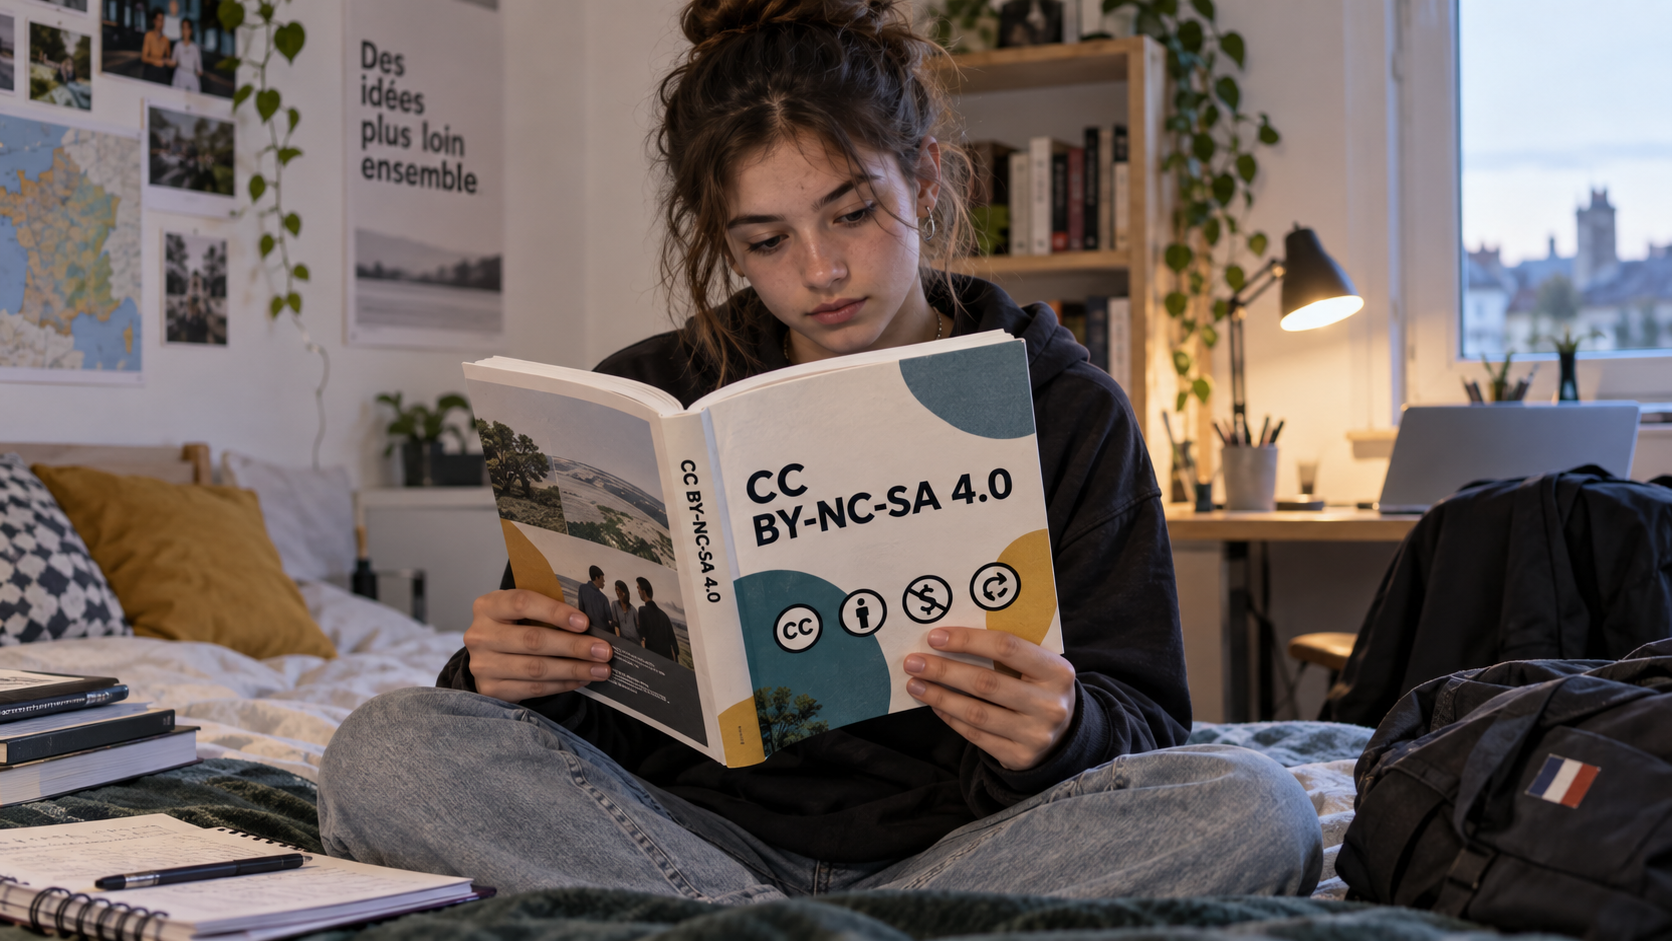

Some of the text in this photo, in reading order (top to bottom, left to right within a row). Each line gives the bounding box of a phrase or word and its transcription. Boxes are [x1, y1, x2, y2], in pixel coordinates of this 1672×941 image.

[361, 39, 405, 77] Des
[361, 74, 425, 115] idées
[361, 113, 465, 158] plus loin
[361, 156, 478, 195] ensemble
[746, 463, 808, 504] CC
[753, 467, 1012, 547] BY-NC-SA 4.0
[680, 459, 721, 603] CC BY-NC-SA 4.0
[782, 617, 814, 640] CC
